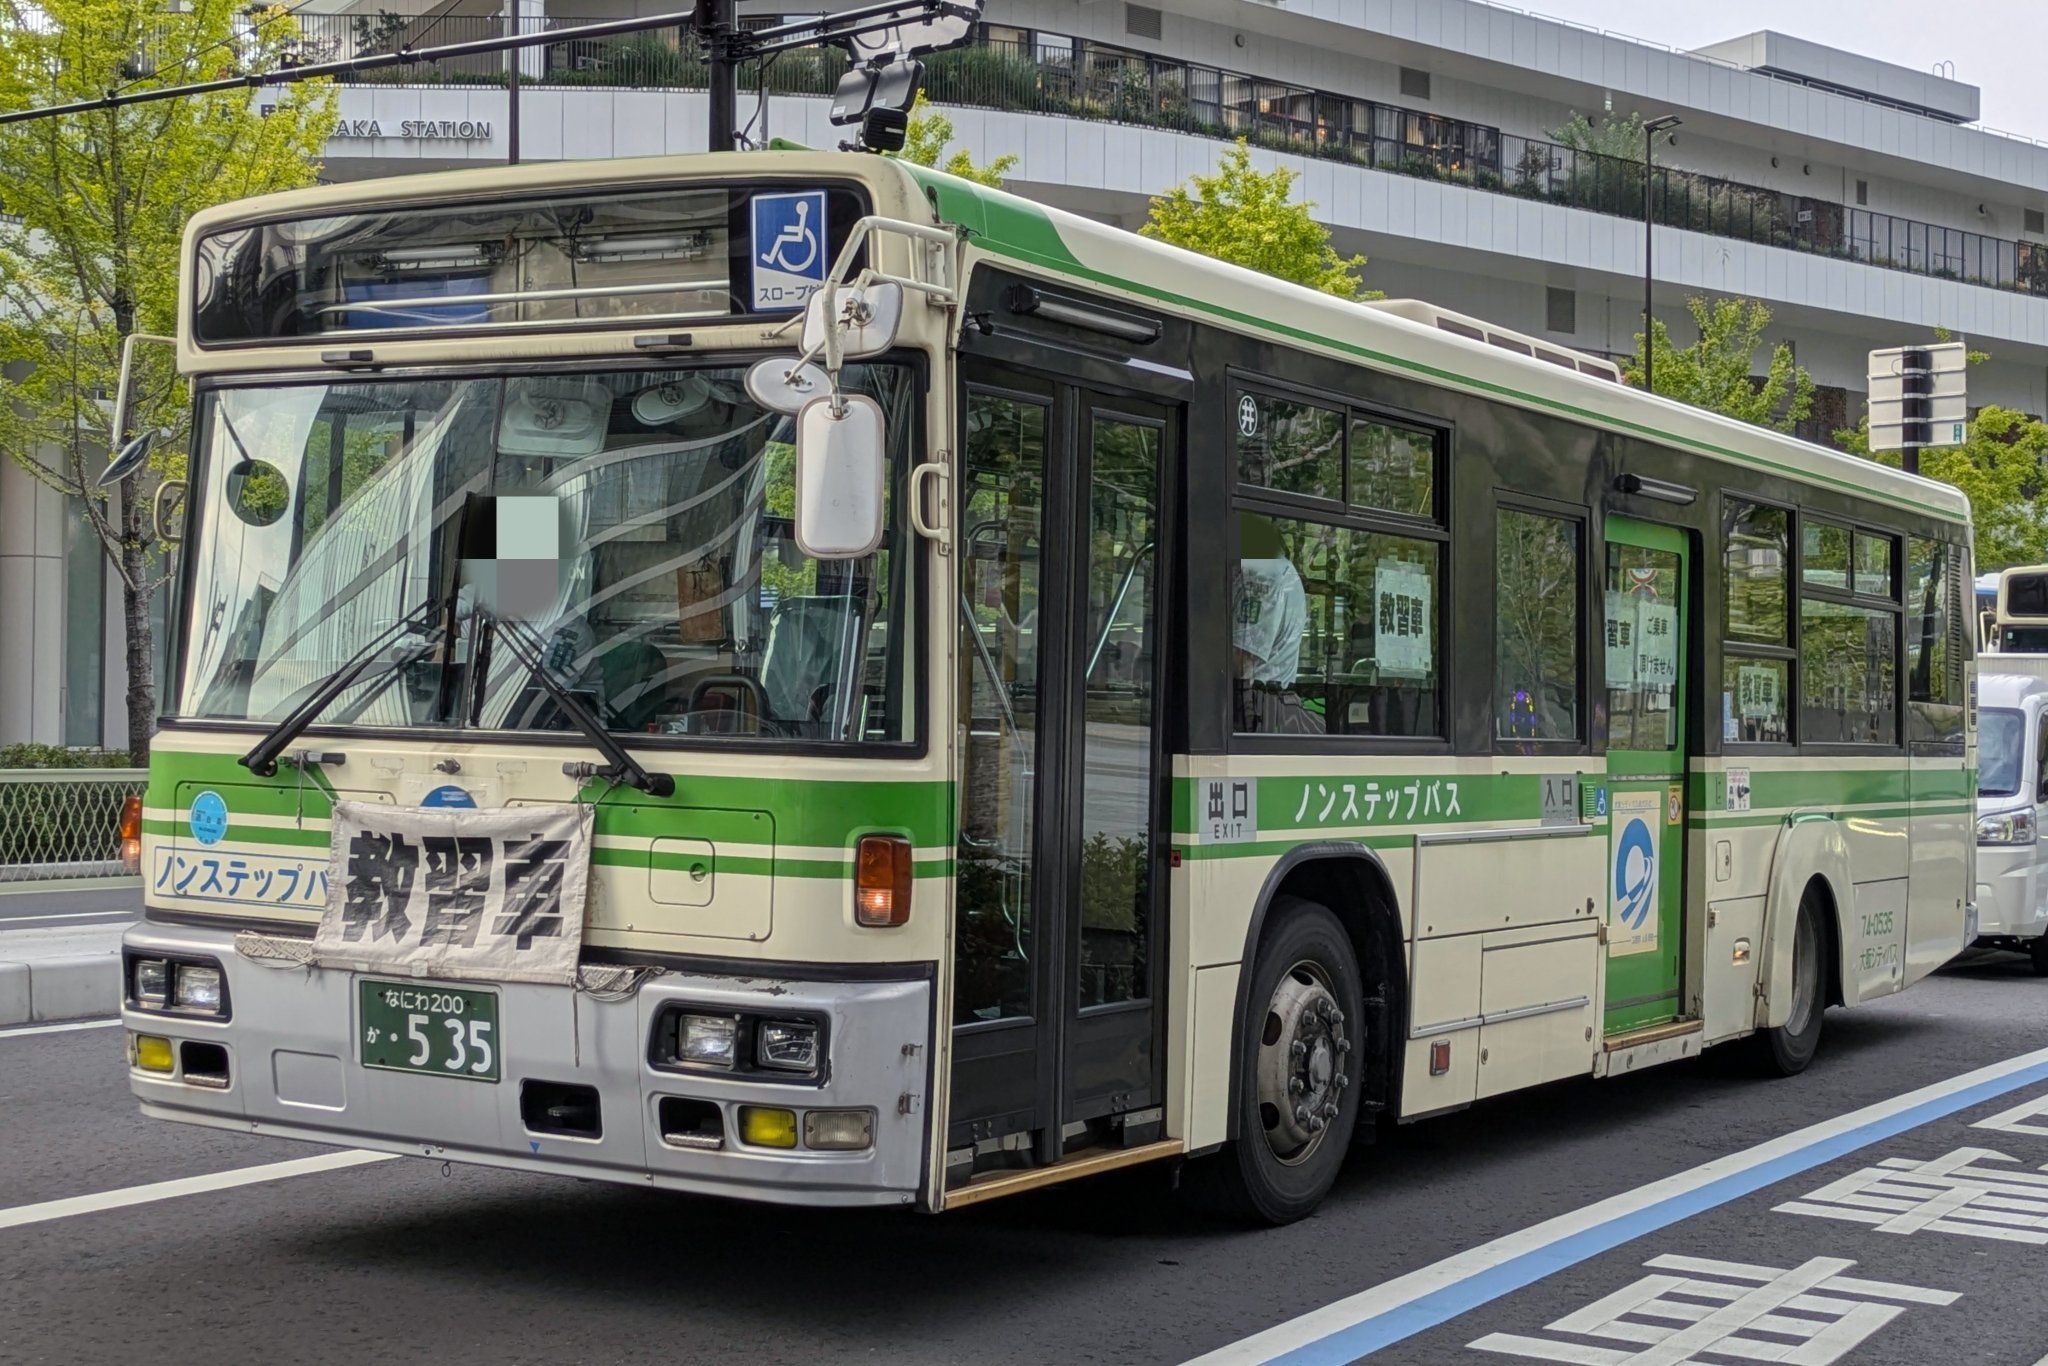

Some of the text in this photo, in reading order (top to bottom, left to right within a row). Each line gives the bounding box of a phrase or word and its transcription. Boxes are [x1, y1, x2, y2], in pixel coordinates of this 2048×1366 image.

[329, 120, 491, 139] AKA STATION
[1379, 591, 1424, 638] 教習車
[1607, 619, 1632, 650] 習車
[1742, 672, 1774, 707] 教習車
[1208, 781, 1248, 821] 出口
[1295, 780, 1461, 823] ノンステップバス
[1545, 779, 1573, 807] 入口
[1214, 823, 1243, 839] EXIT
[341, 830, 571, 951] 教習車
[1861, 911, 1893, 938] 74-0535
[366, 1026, 381, 1044] か
